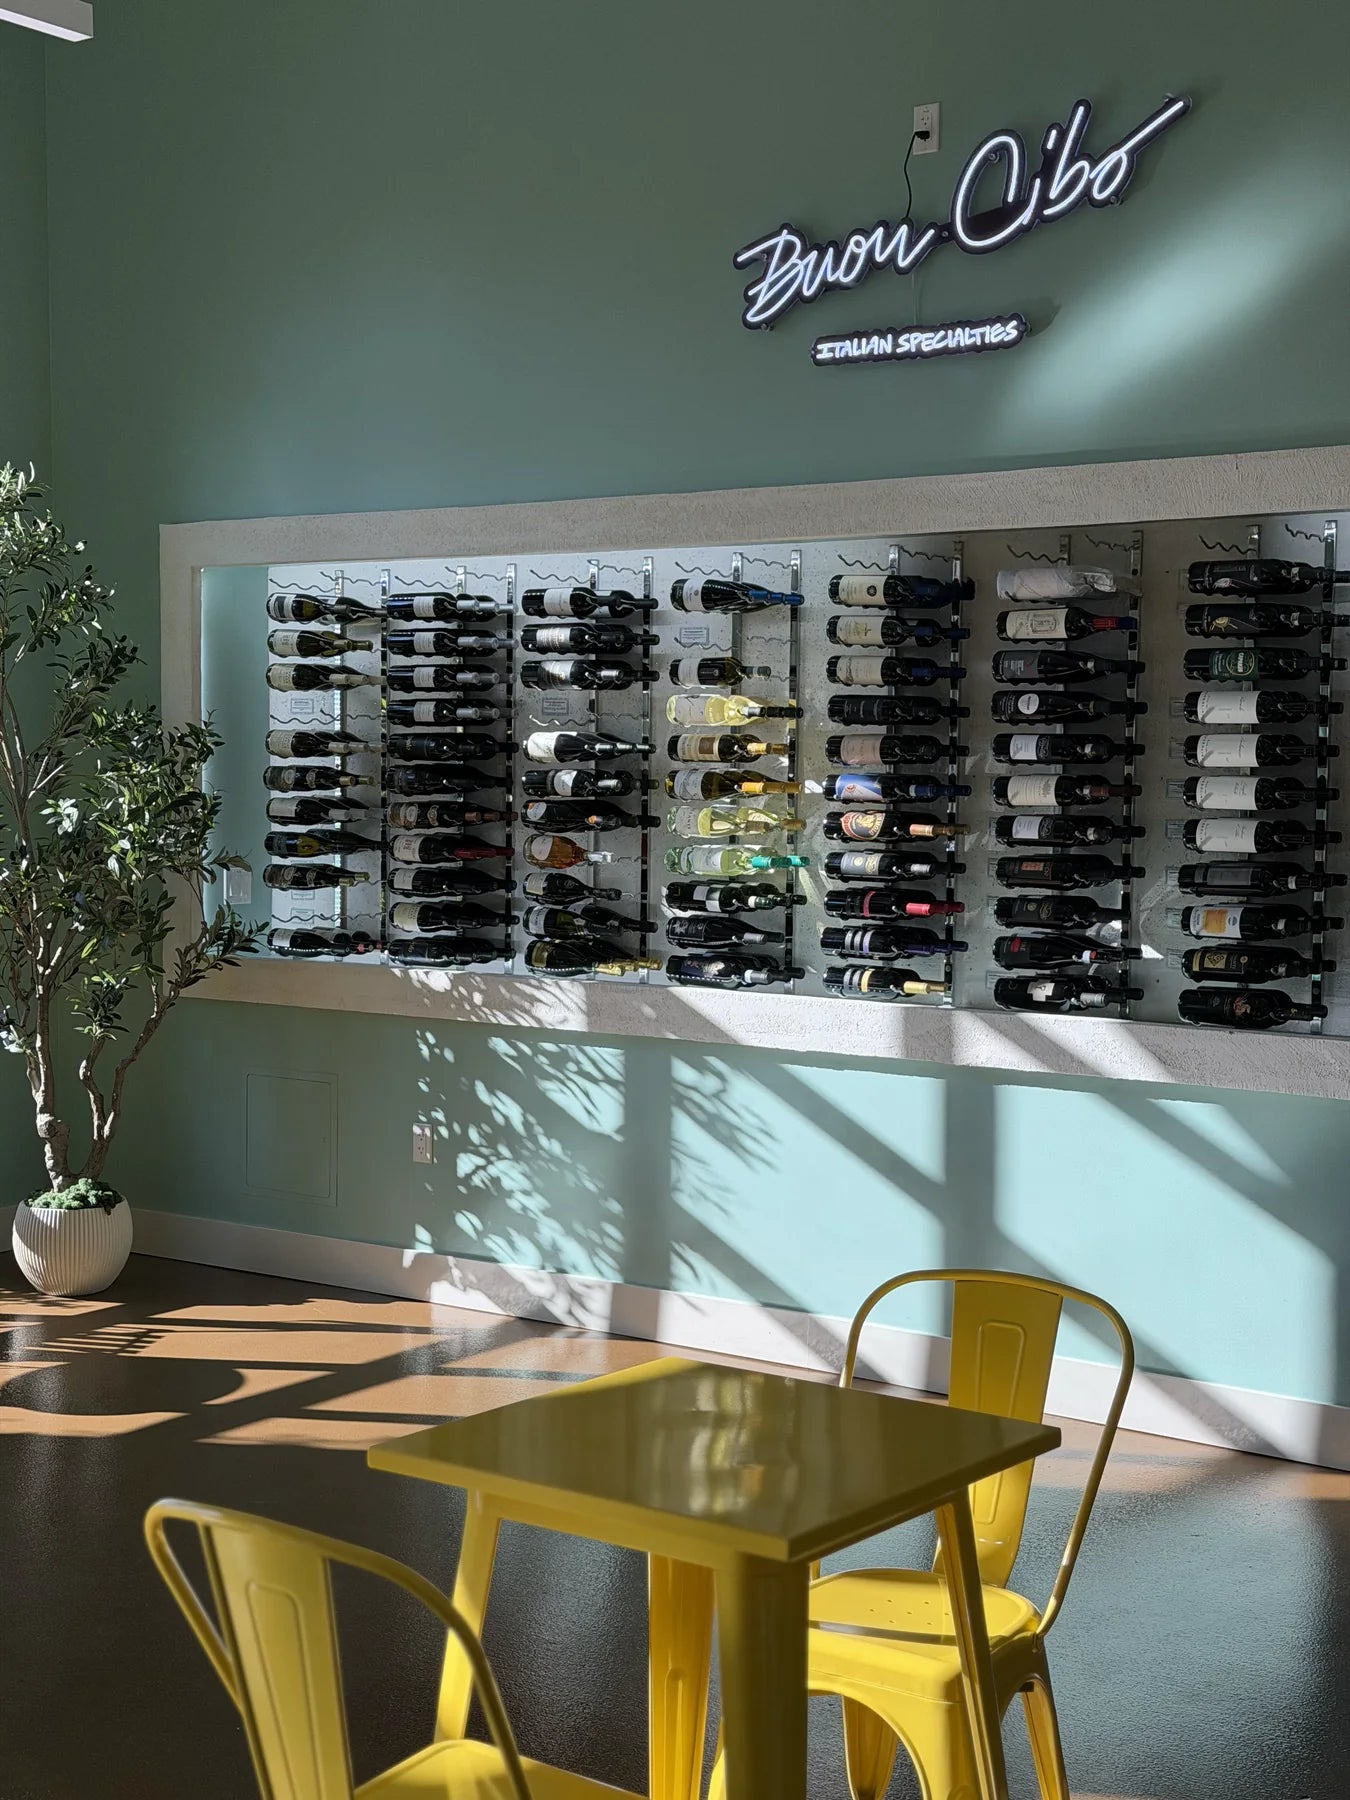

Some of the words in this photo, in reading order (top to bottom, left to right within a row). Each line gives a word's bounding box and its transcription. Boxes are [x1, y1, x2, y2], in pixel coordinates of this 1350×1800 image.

[736, 228, 936, 322] Buon
[954, 100, 1186, 248] Cibo
[816, 333, 893, 360] ITALIAN
[896, 319, 1019, 354] SPECIALTIES
